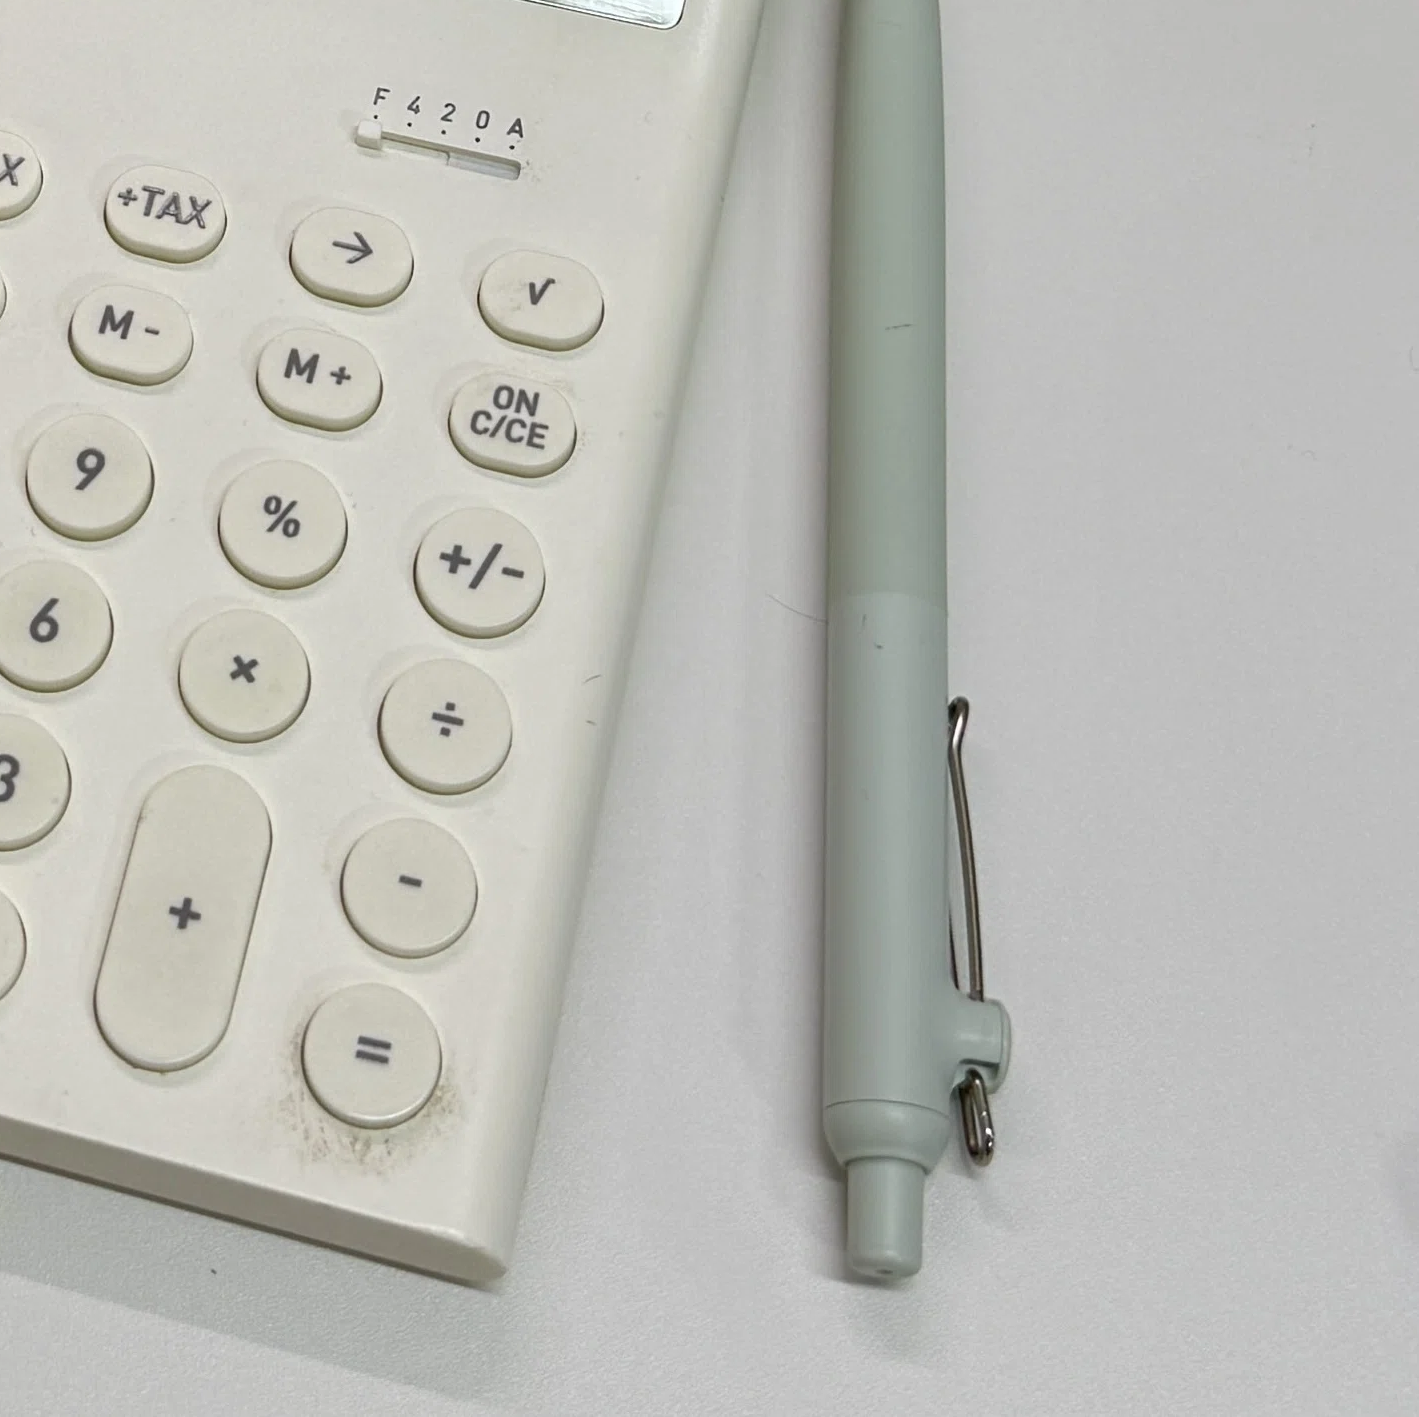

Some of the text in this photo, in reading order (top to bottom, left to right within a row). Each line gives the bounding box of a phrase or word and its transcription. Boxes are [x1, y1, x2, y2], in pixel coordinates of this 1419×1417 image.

[372, 87, 524, 139] F 4 2 0 A
[117, 185, 213, 230] +TAX
[491, 385, 540, 418] ON
[469, 408, 550, 450] C/CE
[75, 447, 106, 491] 9
[263, 495, 301, 539] %
[439, 543, 525, 590] +/-
[28, 597, 60, 644] 6
